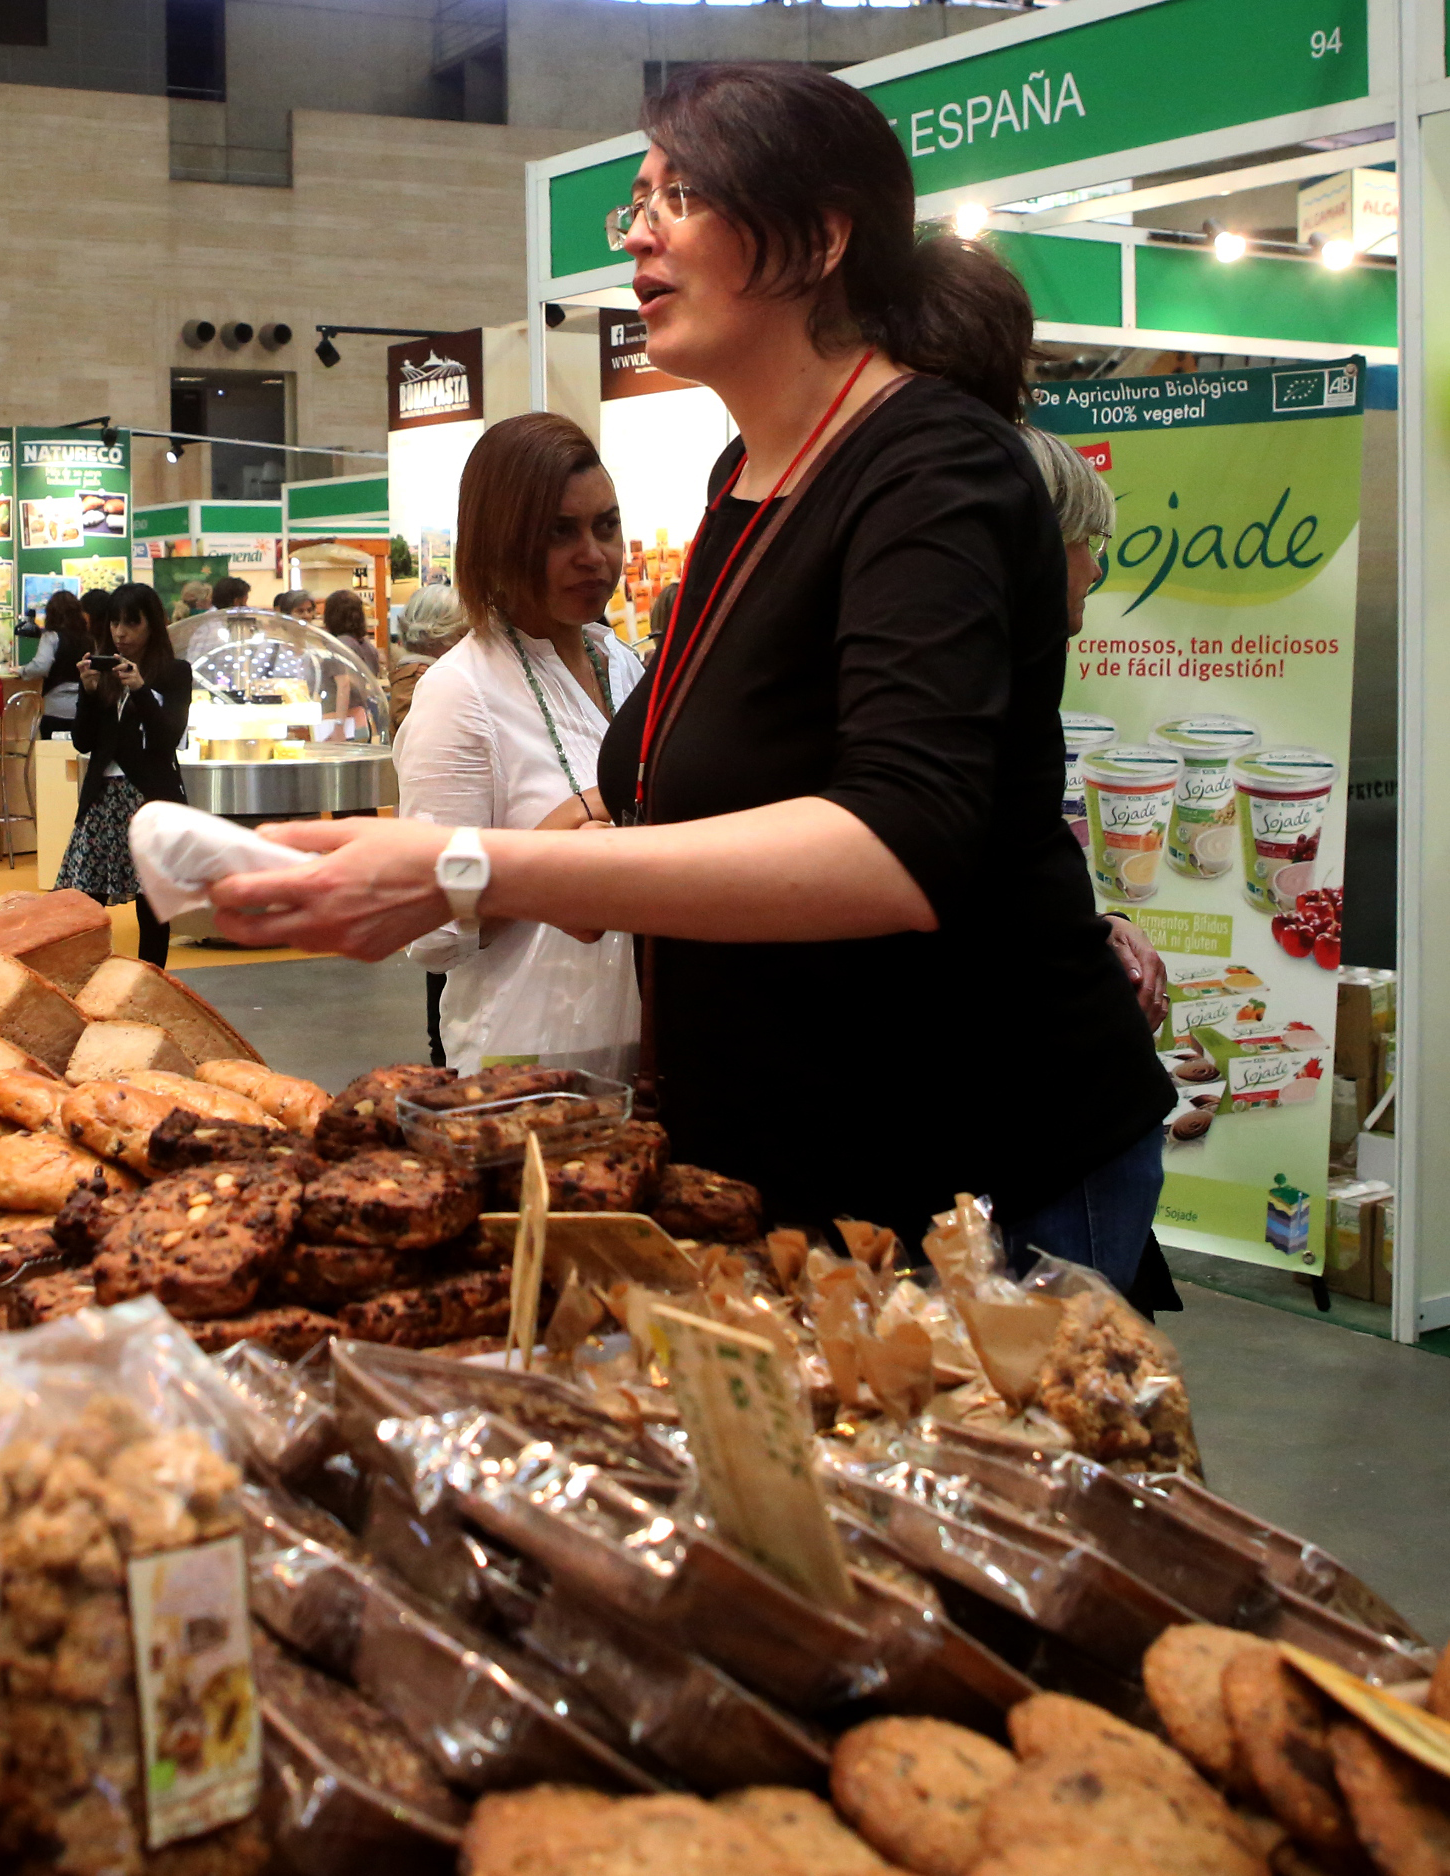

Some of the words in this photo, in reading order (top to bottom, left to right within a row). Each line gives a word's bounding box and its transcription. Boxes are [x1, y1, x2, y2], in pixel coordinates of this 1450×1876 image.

[1310, 26, 1343, 59] 94
[911, 69, 1086, 158] ESPAÑA
[399, 374, 470, 412] BONAPASTA
[1037, 389, 1060, 406] De
[1066, 382, 1160, 408] Agricultura
[1165, 377, 1249, 399] Biológica
[1329, 376, 1350, 393] AB
[1091, 404, 1138, 425] 100%
[1143, 398, 1206, 425] vegetal
[24, 444, 124, 464] NATURECO
[1077, 639, 1183, 657] cremosos,
[1190, 637, 1224, 654] tan
[1231, 635, 1339, 655] deliciosos
[1079, 661, 1091, 679] y
[1096, 658, 1121, 676] de
[1127, 657, 1172, 677] fácil
[1178, 658, 1285, 682] digestión!
[1178, 775, 1234, 802] Sojade
[1104, 801, 1157, 829] Sojade
[1256, 809, 1312, 836] Sojade
[1136, 909, 1190, 930] fermentos
[1193, 914, 1229, 934] Bifidus
[1170, 932, 1181, 947] ni
[1184, 934, 1218, 952] gluten
[1176, 1003, 1229, 1034] Sojade
[1233, 1062, 1290, 1091] Sojade
[1164, 1206, 1199, 1223] Sojade
